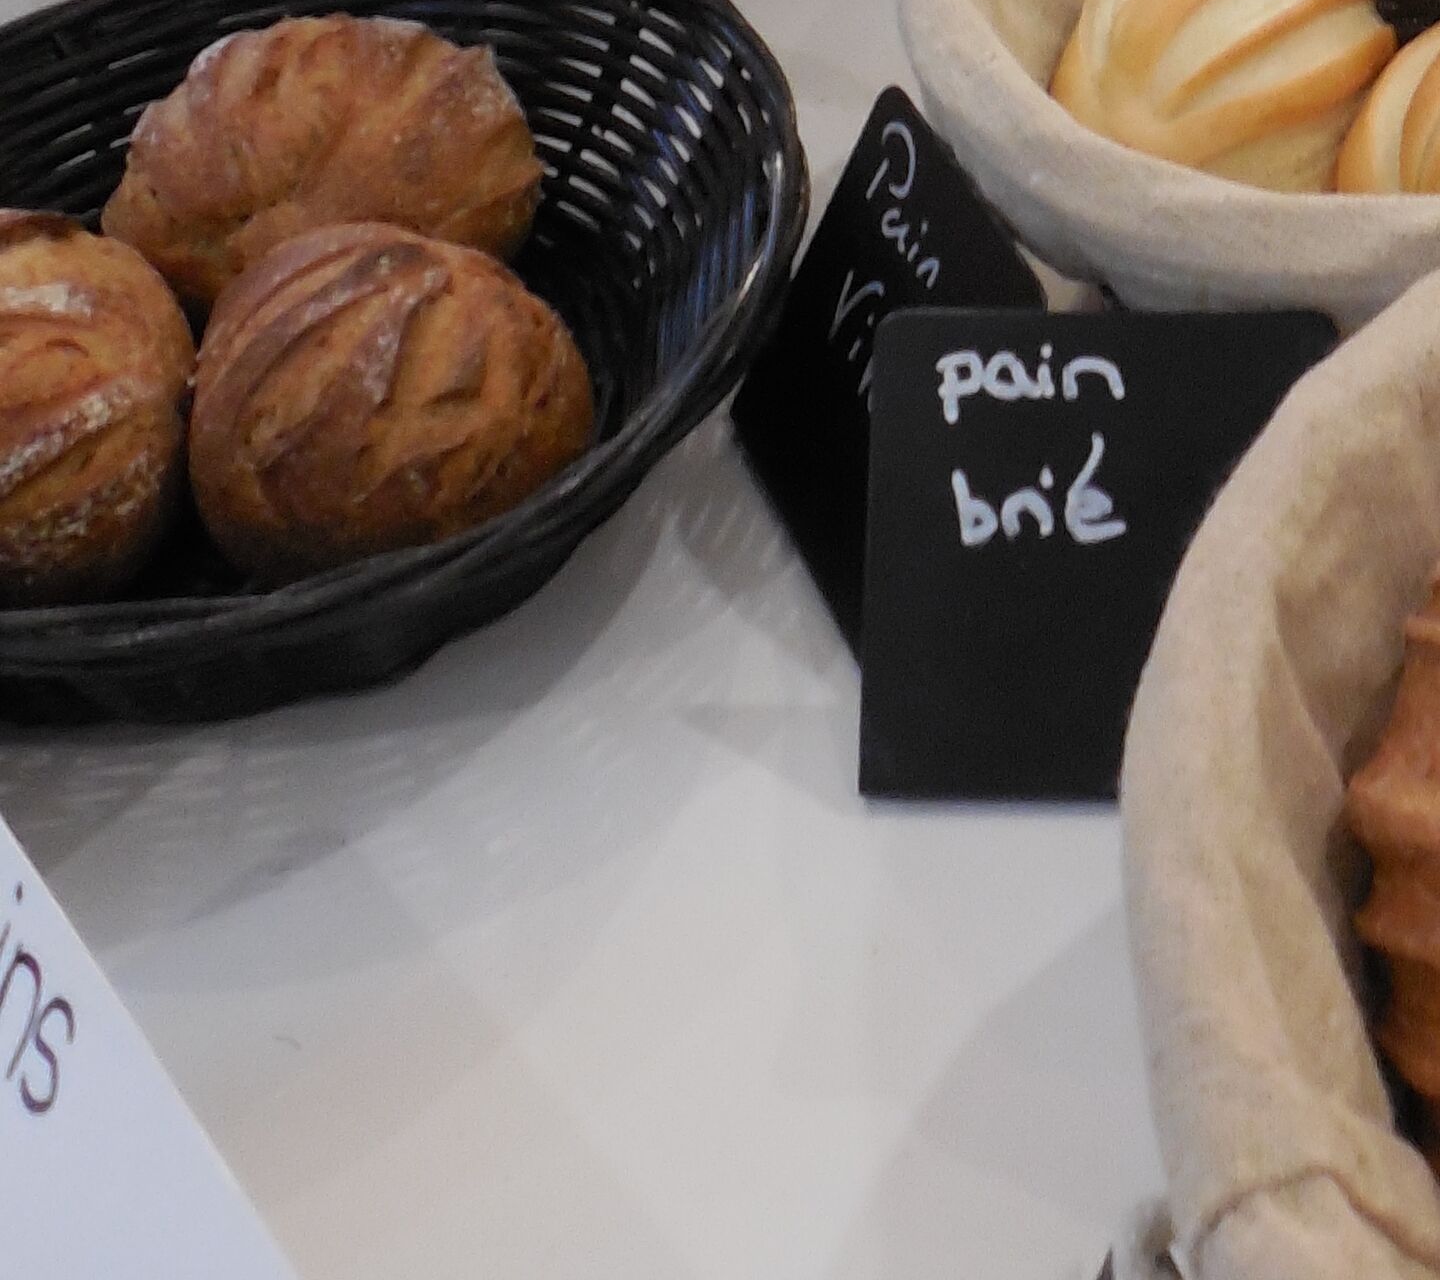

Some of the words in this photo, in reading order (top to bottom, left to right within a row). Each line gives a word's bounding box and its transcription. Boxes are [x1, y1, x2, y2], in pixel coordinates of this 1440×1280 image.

[866, 120, 940, 290] Pain
[936, 342, 1125, 425] pain
[951, 431, 1128, 547] brié
